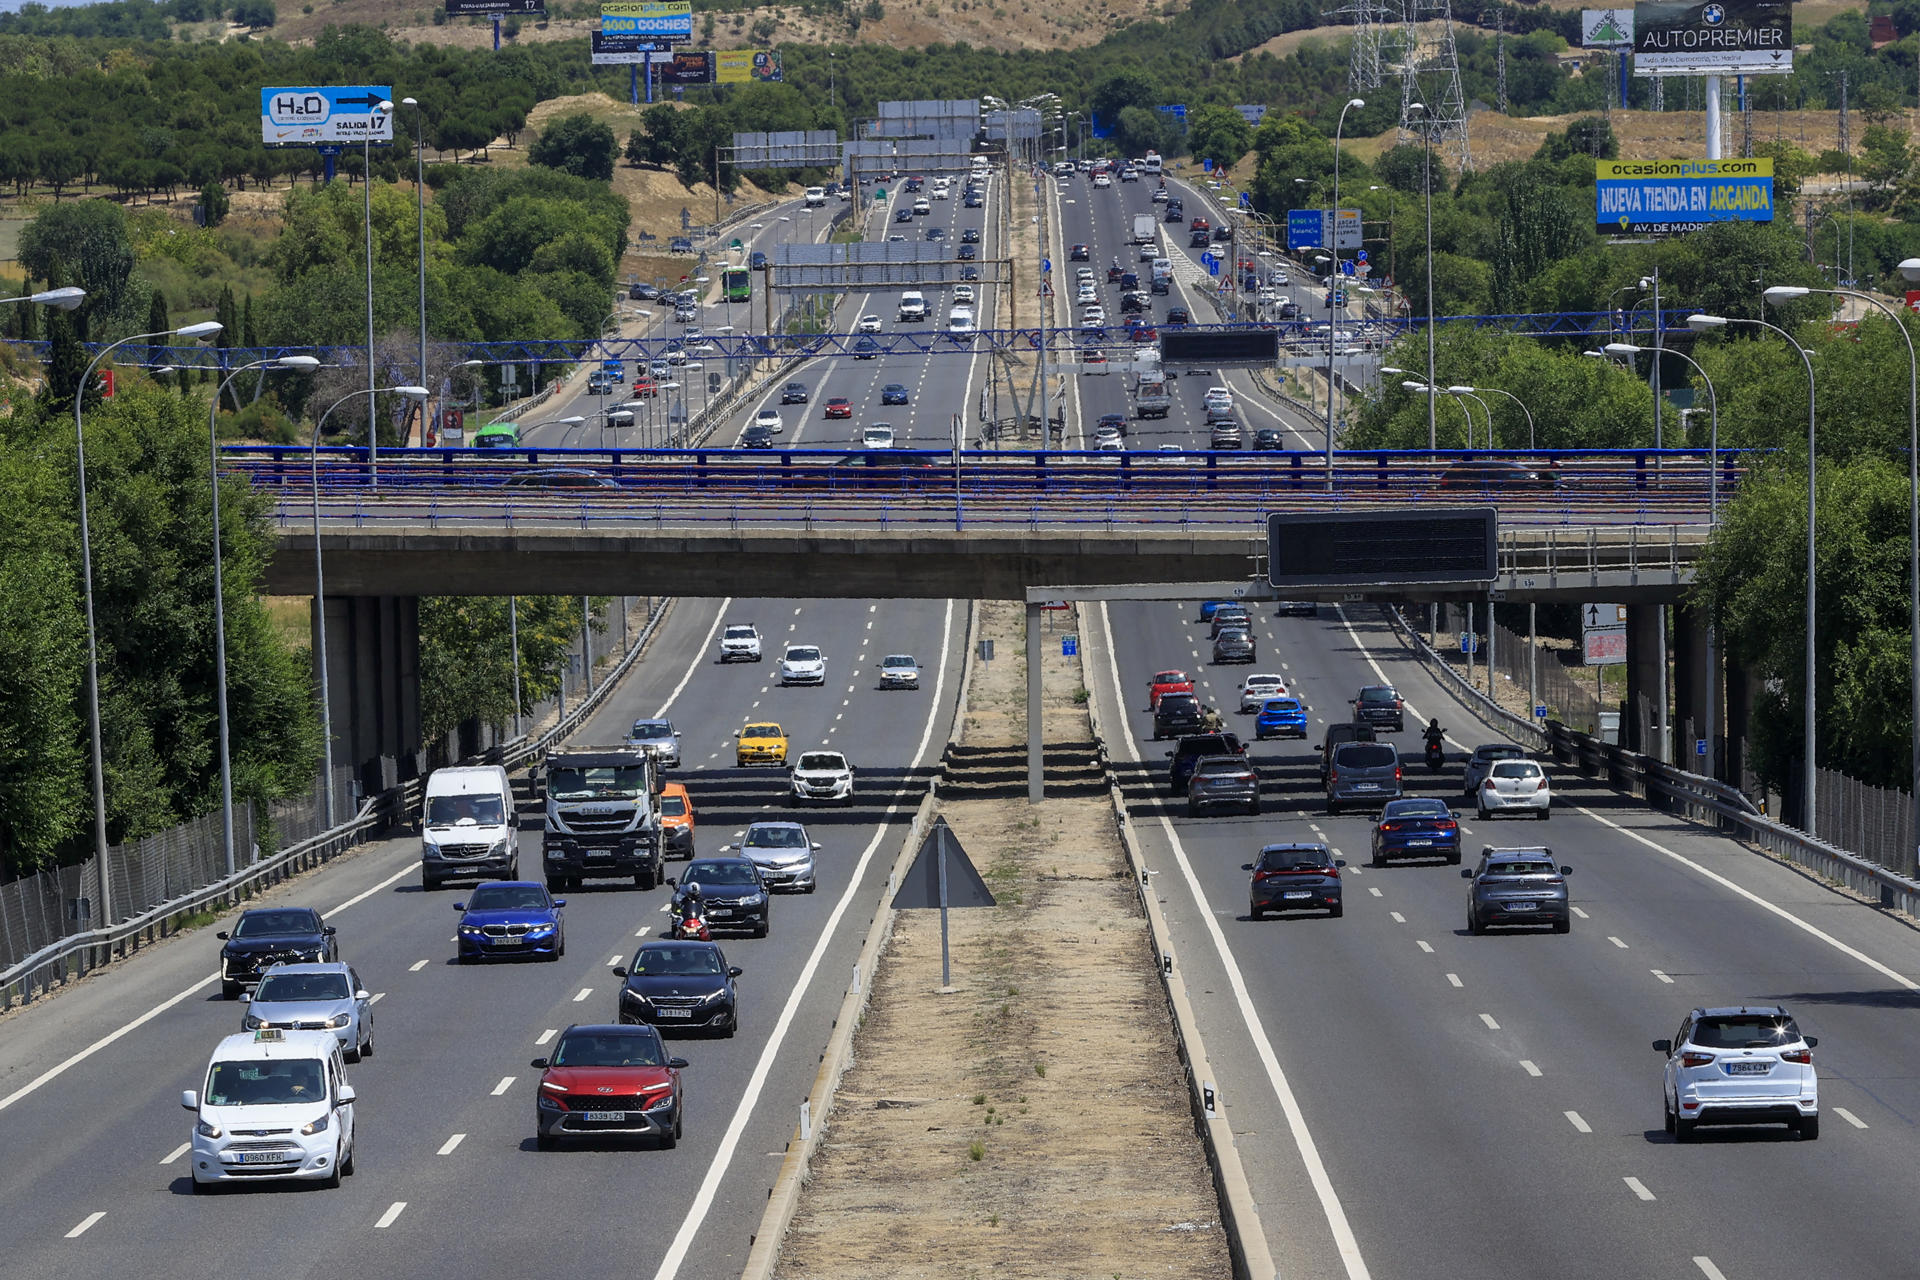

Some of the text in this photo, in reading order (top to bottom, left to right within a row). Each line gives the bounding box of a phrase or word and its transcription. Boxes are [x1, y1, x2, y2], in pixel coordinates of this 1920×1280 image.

[602, 18, 690, 31] 4000 COCHES
[1643, 28, 1784, 48] AUTOPREMIER
[277, 96, 322, 115] H2O
[336, 116, 386, 130] SALIDA 17
[1612, 161, 1757, 177] ocasionplus.com
[1601, 185, 1770, 213] NUEVA TIENDA EN ARGANDA
[1633, 223, 1651, 233] AV.
[1653, 223, 1668, 232] DE
[244, 1153, 265, 1162] 0960
